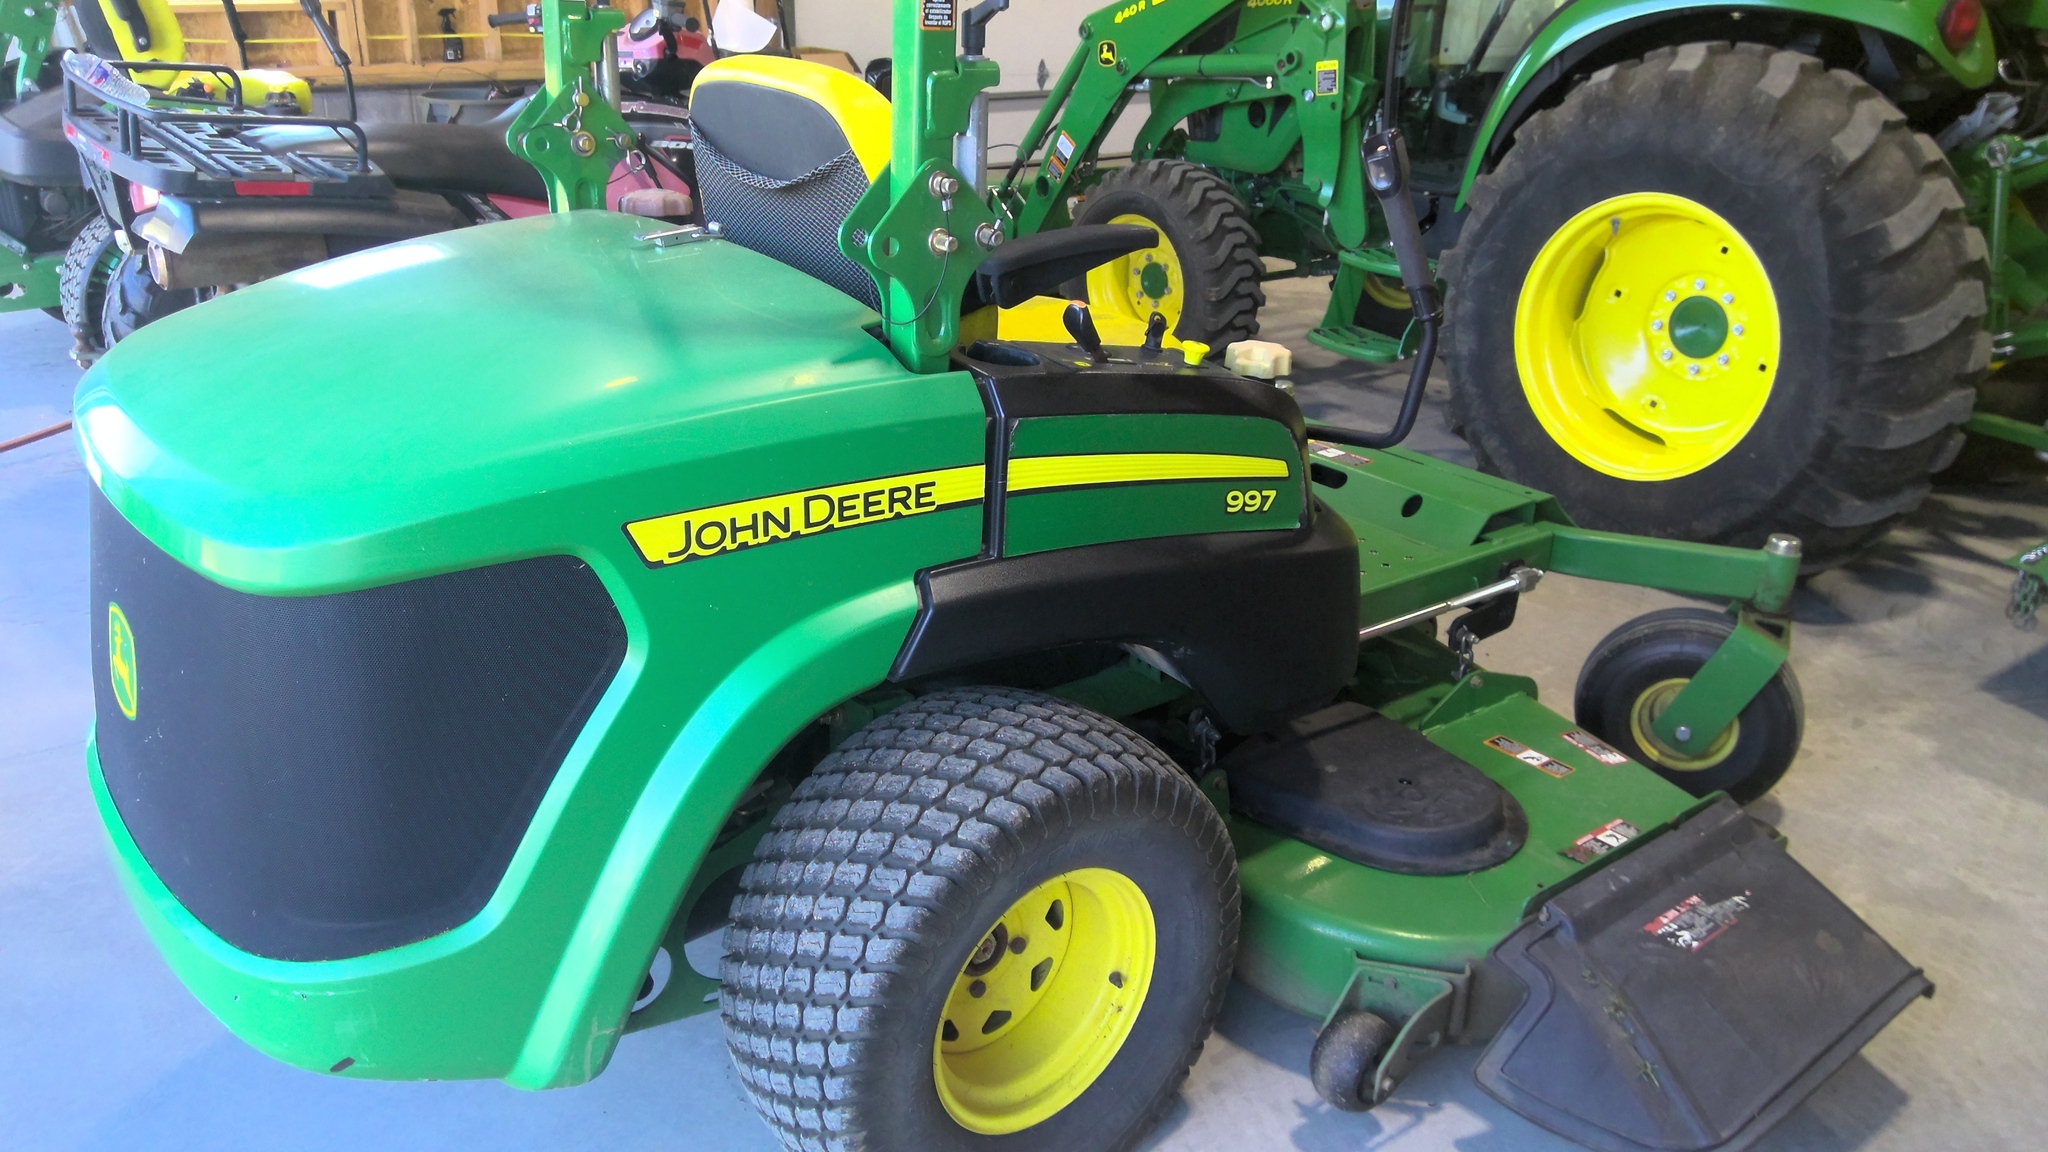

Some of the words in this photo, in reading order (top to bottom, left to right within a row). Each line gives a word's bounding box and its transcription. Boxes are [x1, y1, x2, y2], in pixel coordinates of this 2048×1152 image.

[667, 507, 790, 559] JOHN
[804, 481, 937, 528] DEERE
[1226, 490, 1277, 513] 997
